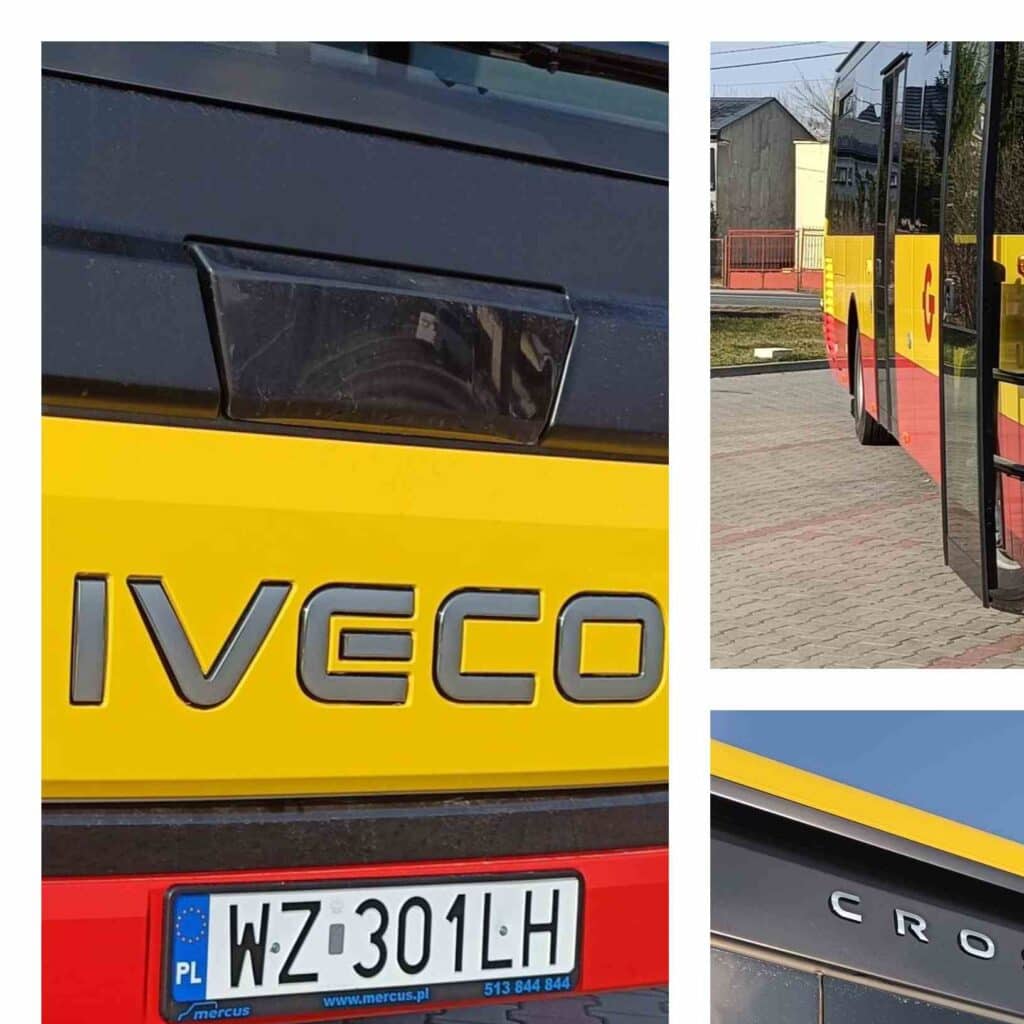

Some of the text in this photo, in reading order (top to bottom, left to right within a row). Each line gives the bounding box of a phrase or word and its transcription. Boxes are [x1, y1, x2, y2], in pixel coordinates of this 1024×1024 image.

[69, 572, 665, 711] IVECO
[229, 889, 559, 988] WZ 301LH
[175, 960, 202, 985] PL
[323, 987, 430, 1008] www.mercus.pl
[484, 976, 570, 996] 513 844 844
[193, 1006, 250, 1020] mercus
